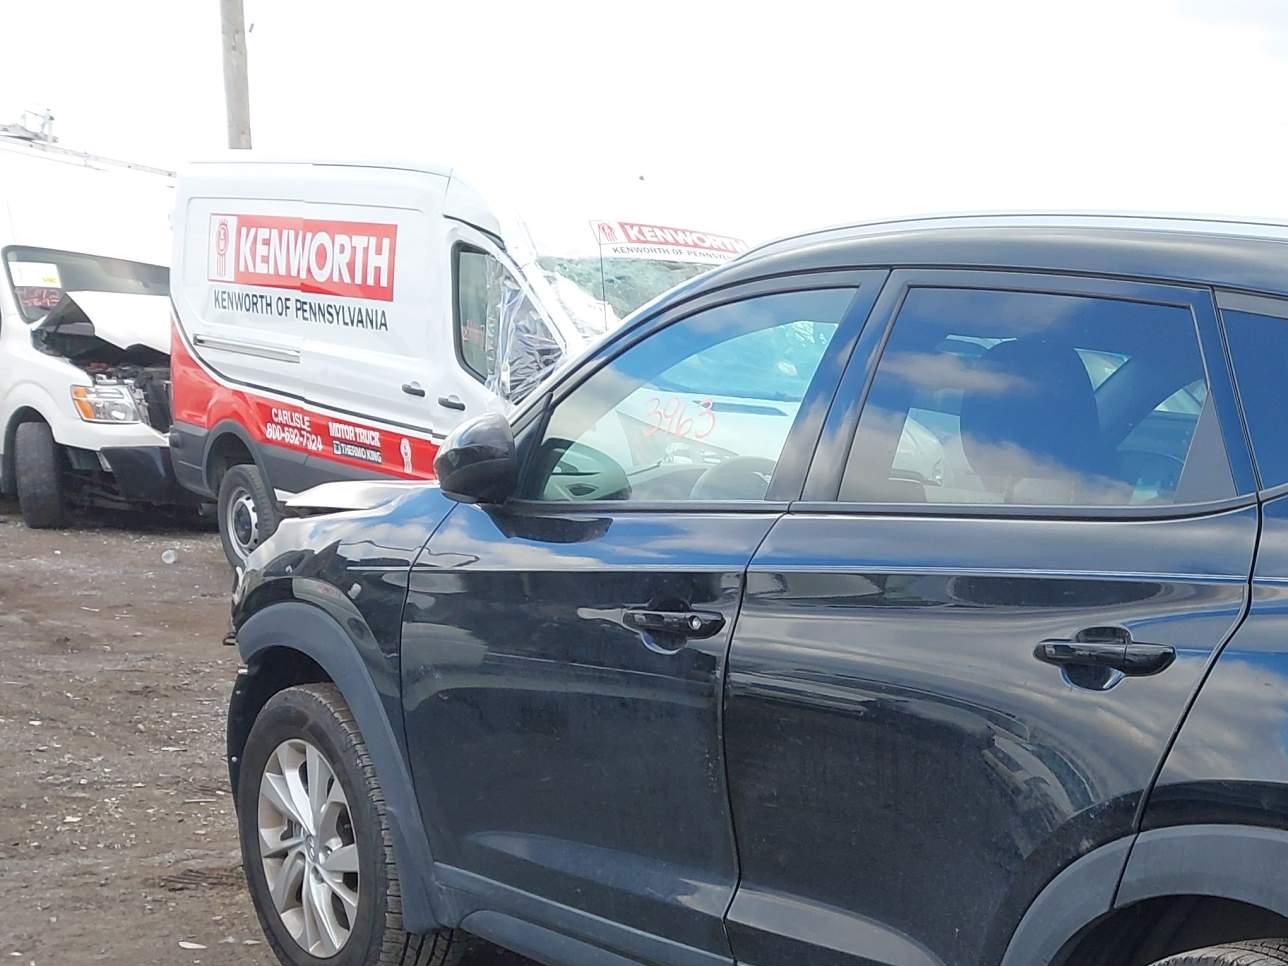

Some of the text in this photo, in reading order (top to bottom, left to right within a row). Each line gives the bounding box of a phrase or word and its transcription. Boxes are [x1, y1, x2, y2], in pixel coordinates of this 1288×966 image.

[612, 246, 670, 256] KENWORTH
[672, 248, 685, 257] OF
[622, 224, 748, 252] KENWORTH
[239, 226, 391, 288] KENWORTH
[213, 289, 389, 332] KENWORTH OF PENNSYLVANIA
[271, 407, 312, 431] CARLISLE
[642, 396, 716, 438] 3963
[265, 422, 323, 452] 800-692-7324
[328, 421, 382, 448] MOTOR TRUCK
[341, 443, 383, 464] THERMO KING
